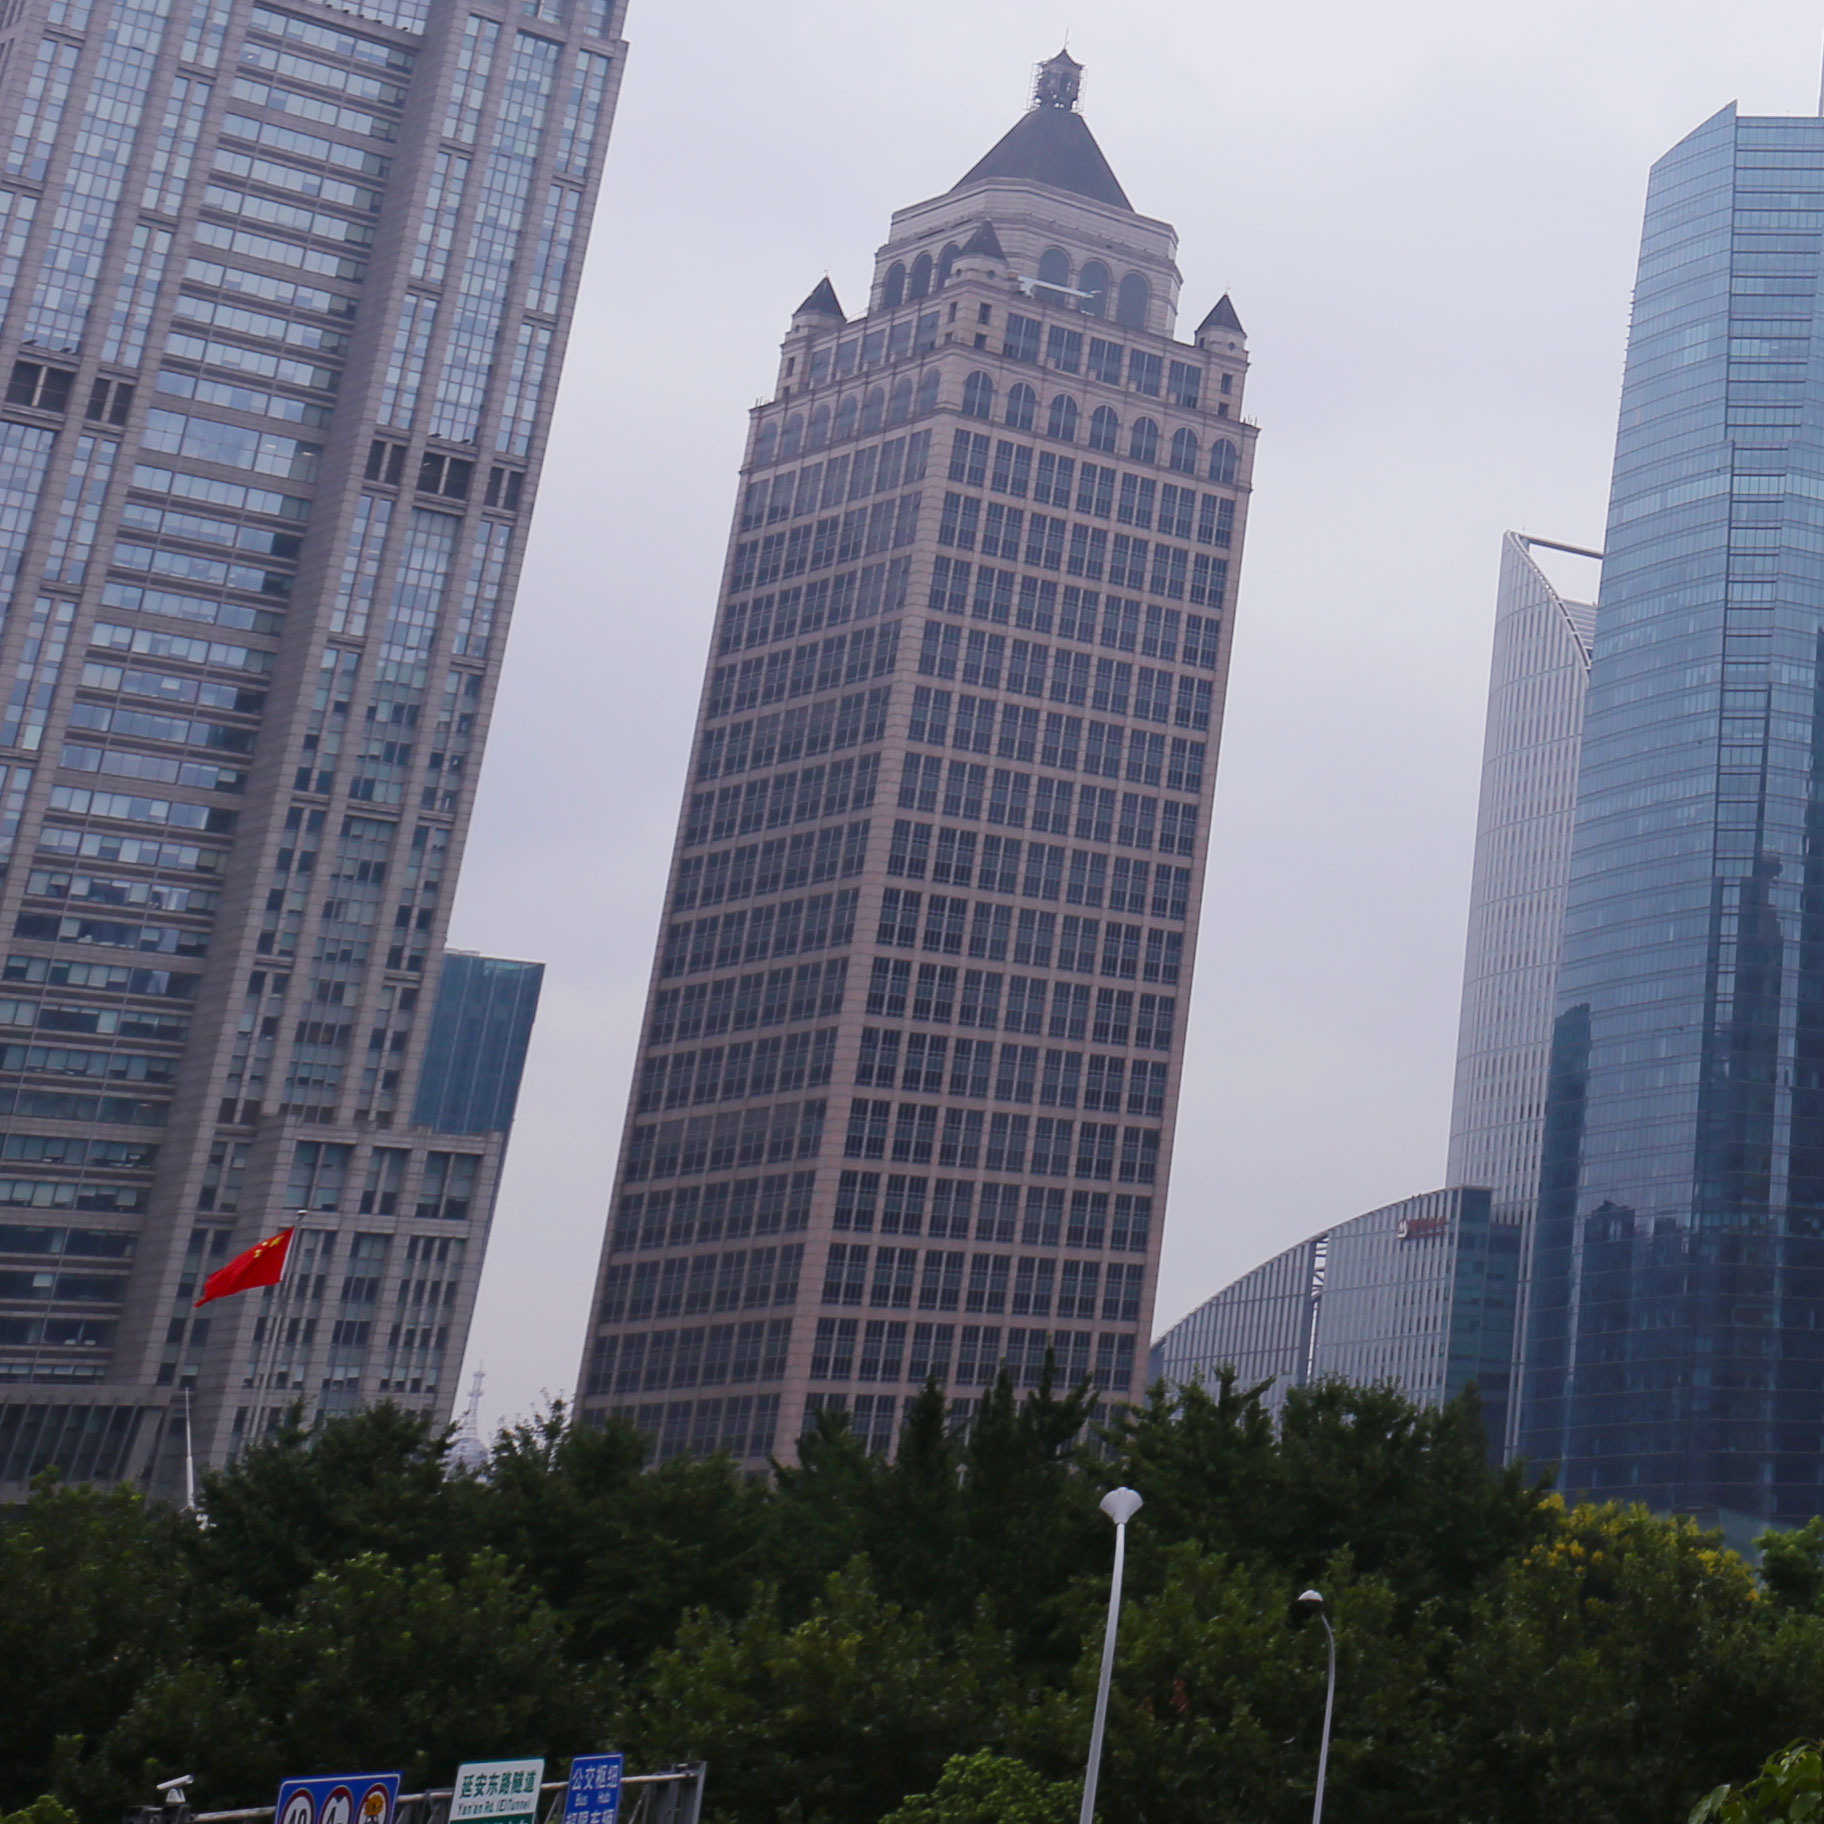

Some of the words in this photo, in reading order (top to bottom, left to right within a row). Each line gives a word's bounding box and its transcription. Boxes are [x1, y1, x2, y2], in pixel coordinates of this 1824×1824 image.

[460, 1770, 536, 1799] 延安东路隧道
